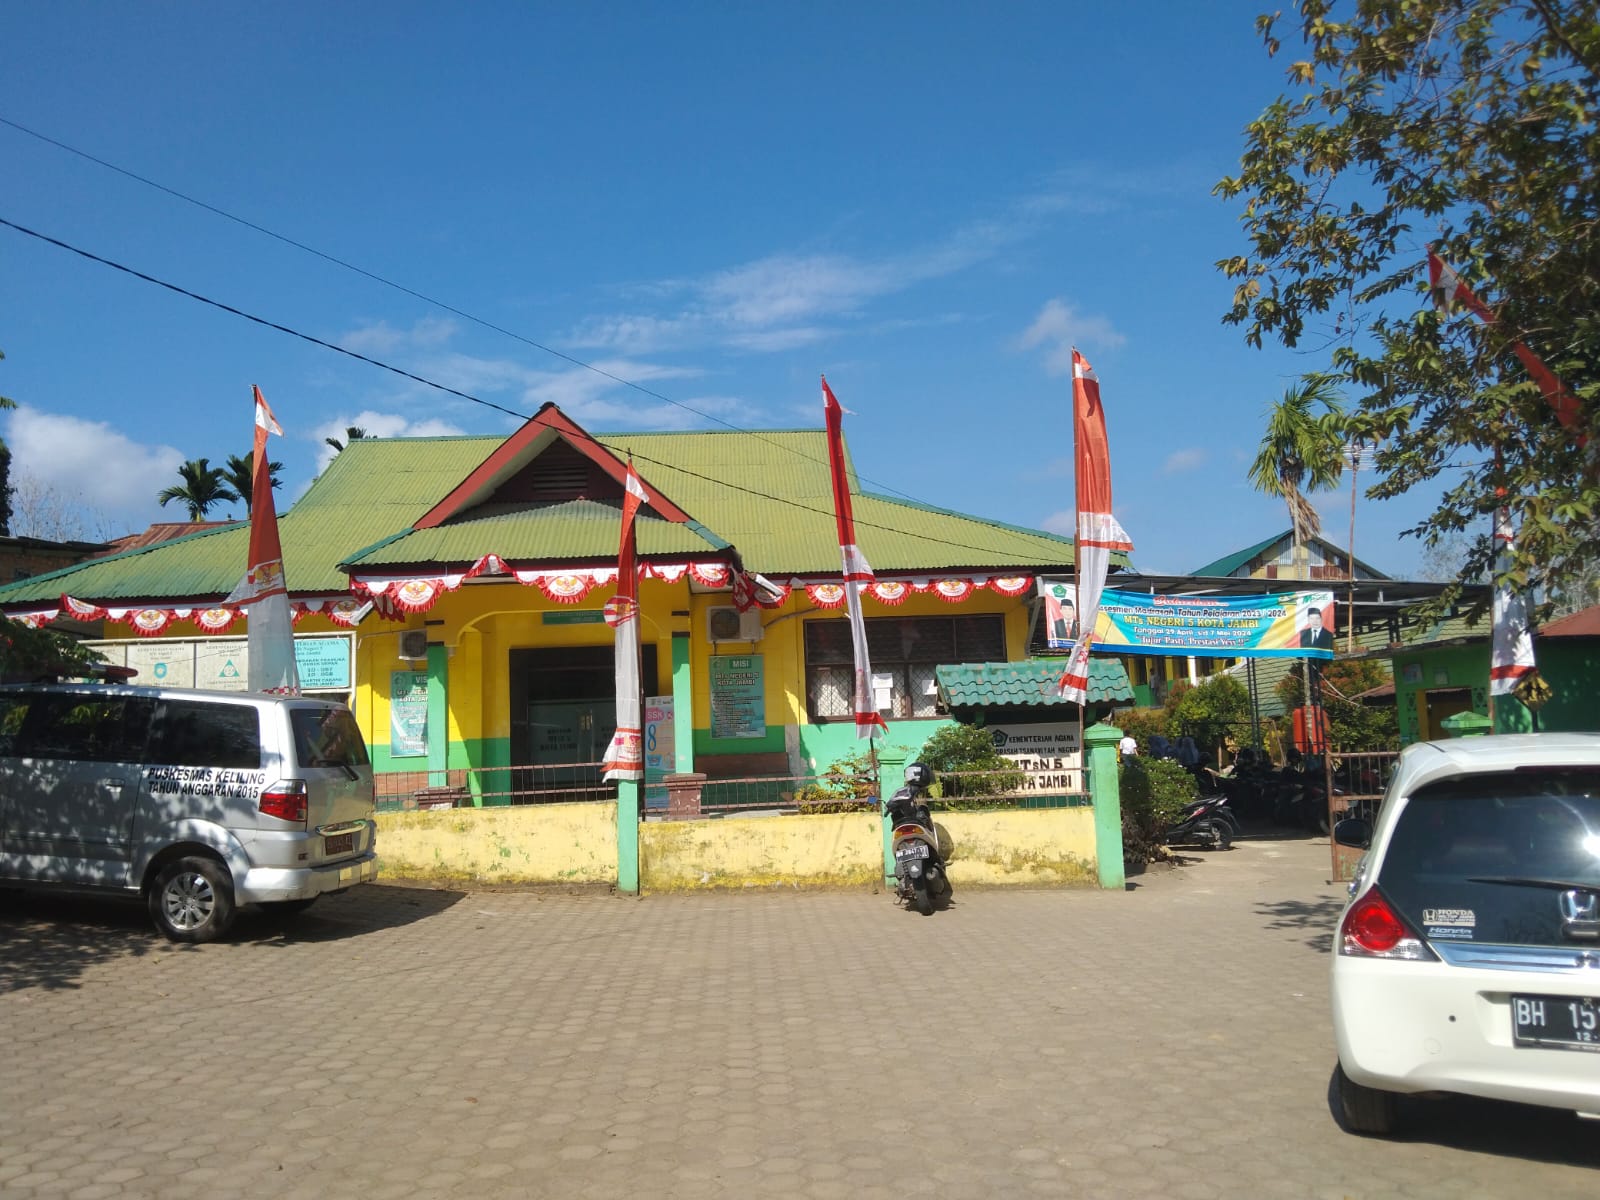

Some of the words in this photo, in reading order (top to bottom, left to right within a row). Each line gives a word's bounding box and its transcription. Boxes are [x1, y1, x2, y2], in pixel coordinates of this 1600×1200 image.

[1135, 607, 1174, 616] Madrasah
[1178, 608, 1201, 617] Tahun
[1203, 609, 1240, 618] Pelajaran
[1242, 609, 1261, 617] 2023
[1268, 609, 1287, 618] 2024
[1124, 615, 1144, 625] MTs
[1147, 616, 1184, 626] NEGERI
[1188, 618, 1194, 627] 5
[1197, 618, 1224, 628] KOTA
[1227, 618, 1259, 628] JAMBI
[1134, 626, 1164, 635] Tanggal
[732, 660, 749, 668] MISI
[415, 675, 428, 683] VIS
[648, 724, 657, 752] 8
[1009, 735, 1052, 743] KEMENTERIAN
[1054, 734, 1074, 742] AGAMA
[1054, 758, 1063, 769] 5
[148, 768, 213, 782] PUSKESMAS
[215, 770, 266, 785] KELILING
[1038, 775, 1072, 789] JAMBI
[149, 782, 180, 794] TAHUN
[181, 783, 234, 797] ANGGARAN
[236, 785, 259, 799] 2015
[1517, 999, 1546, 1027] BH
[1568, 1002, 1600, 1030] 15
